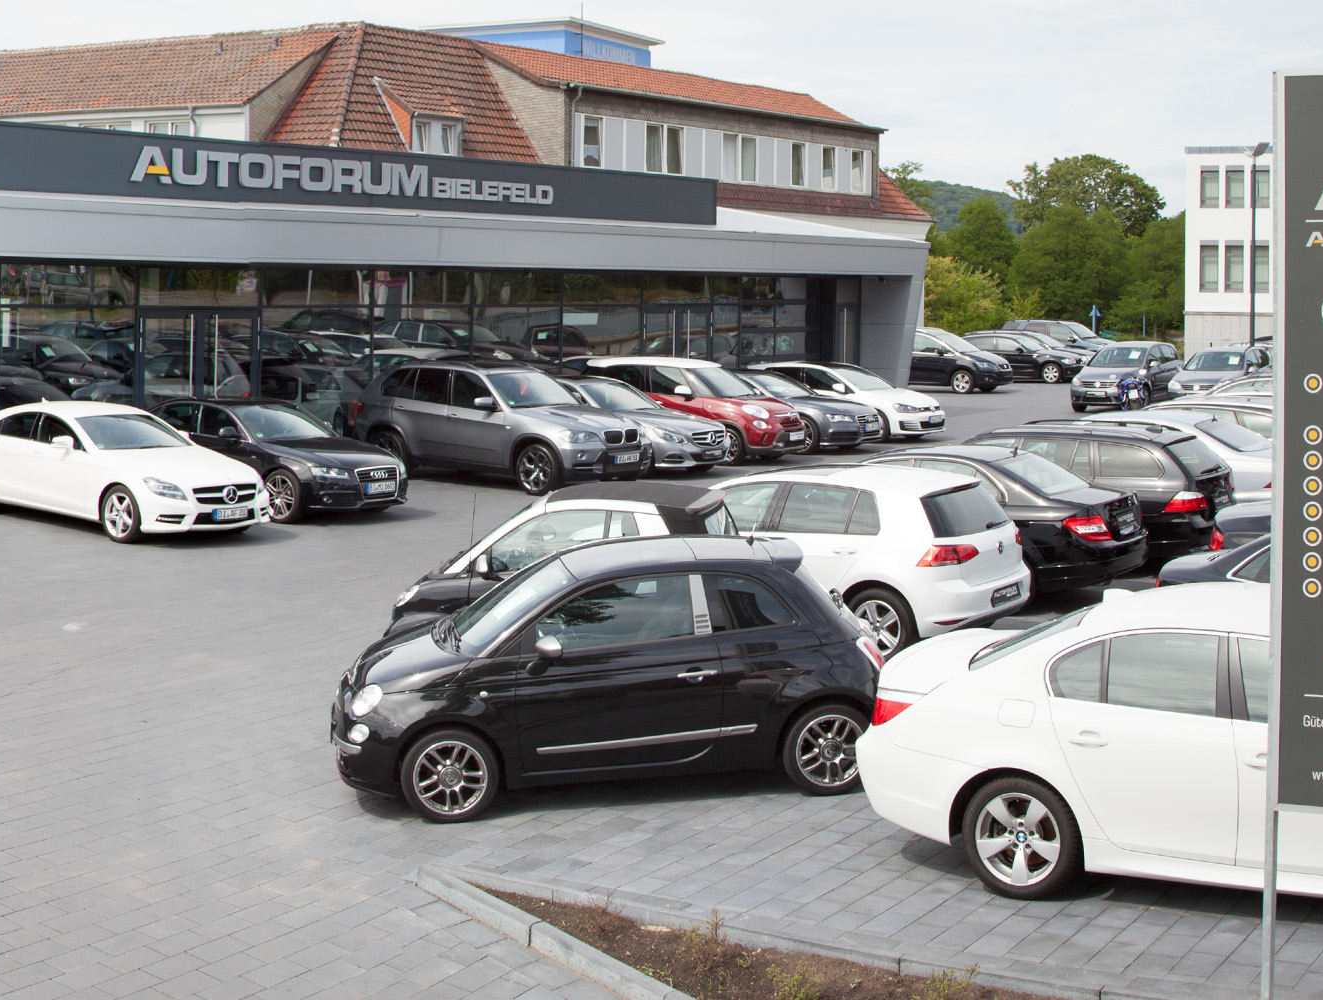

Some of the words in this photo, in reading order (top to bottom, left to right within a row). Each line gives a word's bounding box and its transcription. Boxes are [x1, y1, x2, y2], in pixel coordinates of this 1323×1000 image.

[583, 38, 636, 65] WILLKOMMEN
[129, 145, 428, 198] AUTOFORUM
[431, 176, 554, 205] BIELEFELD
